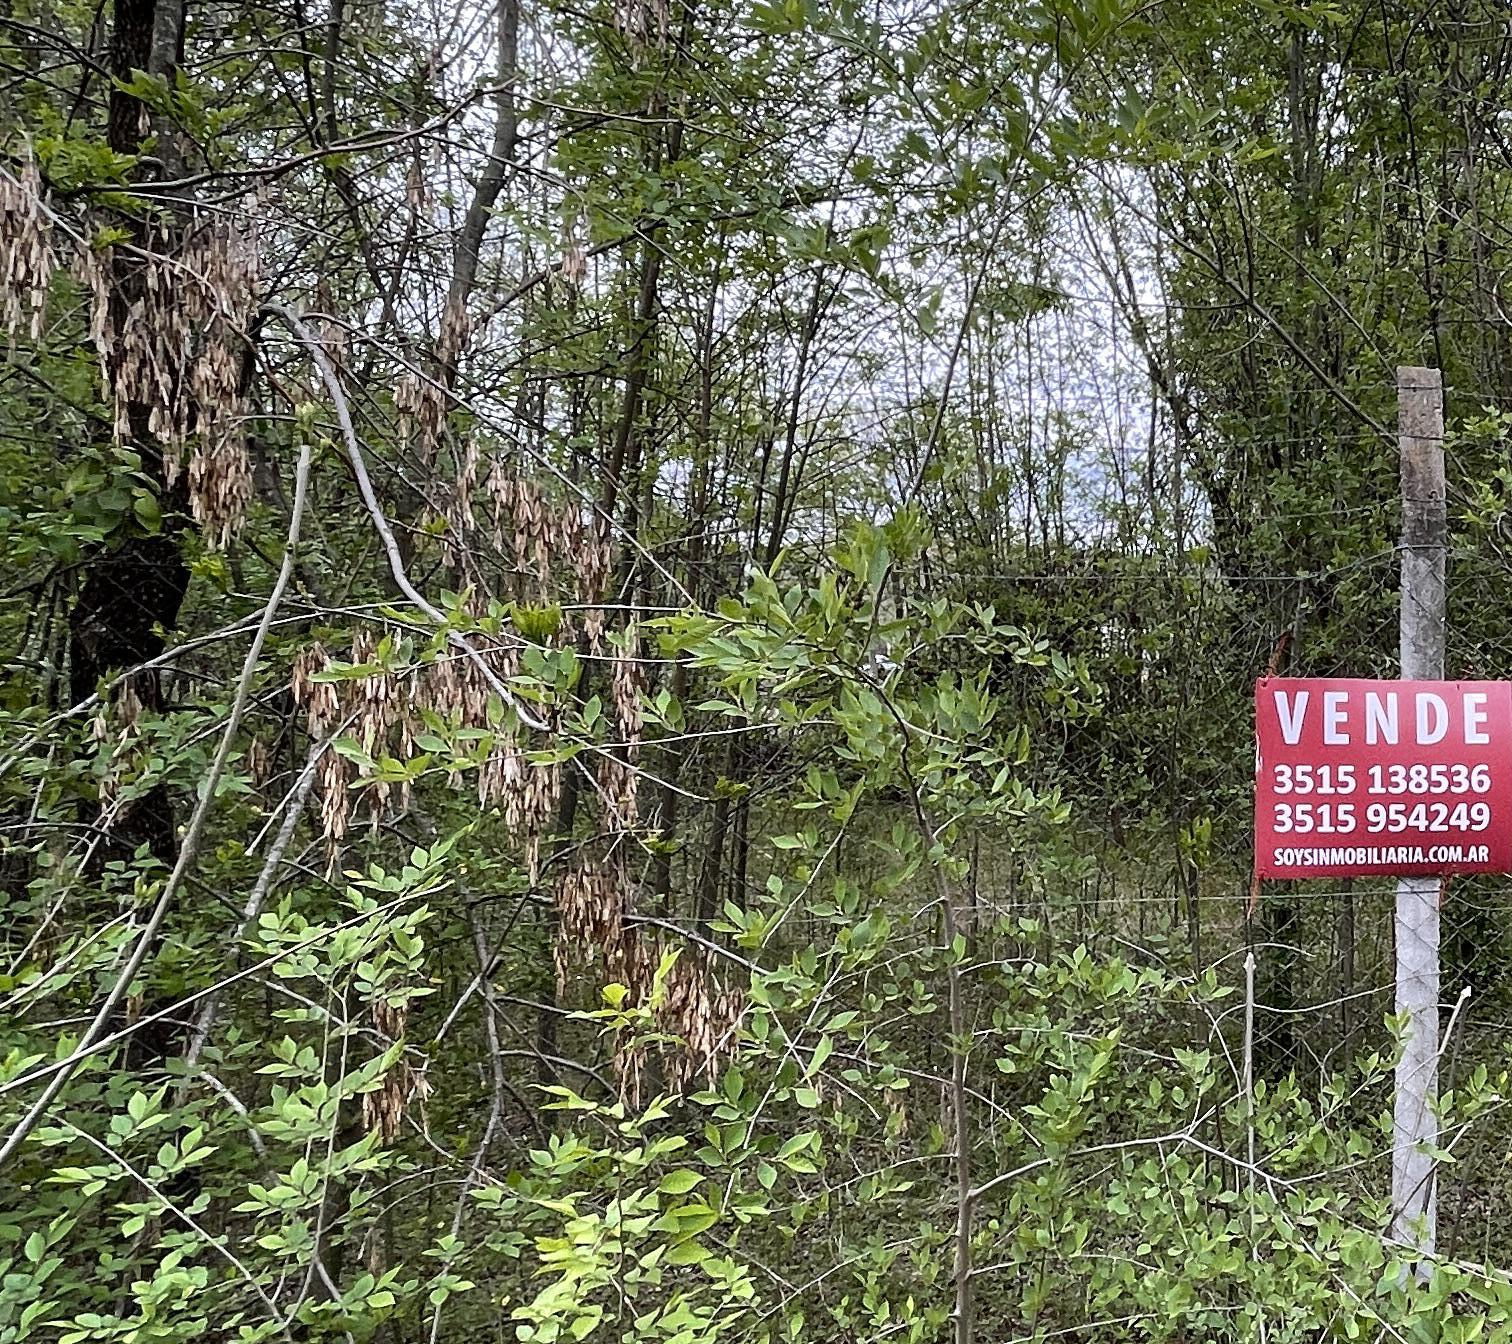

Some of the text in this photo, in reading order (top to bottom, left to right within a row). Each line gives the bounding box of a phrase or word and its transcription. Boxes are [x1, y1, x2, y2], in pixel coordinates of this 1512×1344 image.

[1273, 690, 1490, 745] VENDE
[1273, 763, 1491, 795] 3515 138536
[1273, 802, 1491, 834] 3515 954249
[1273, 845, 1489, 867] SOYSINMOBILIARIA.COM.AR
